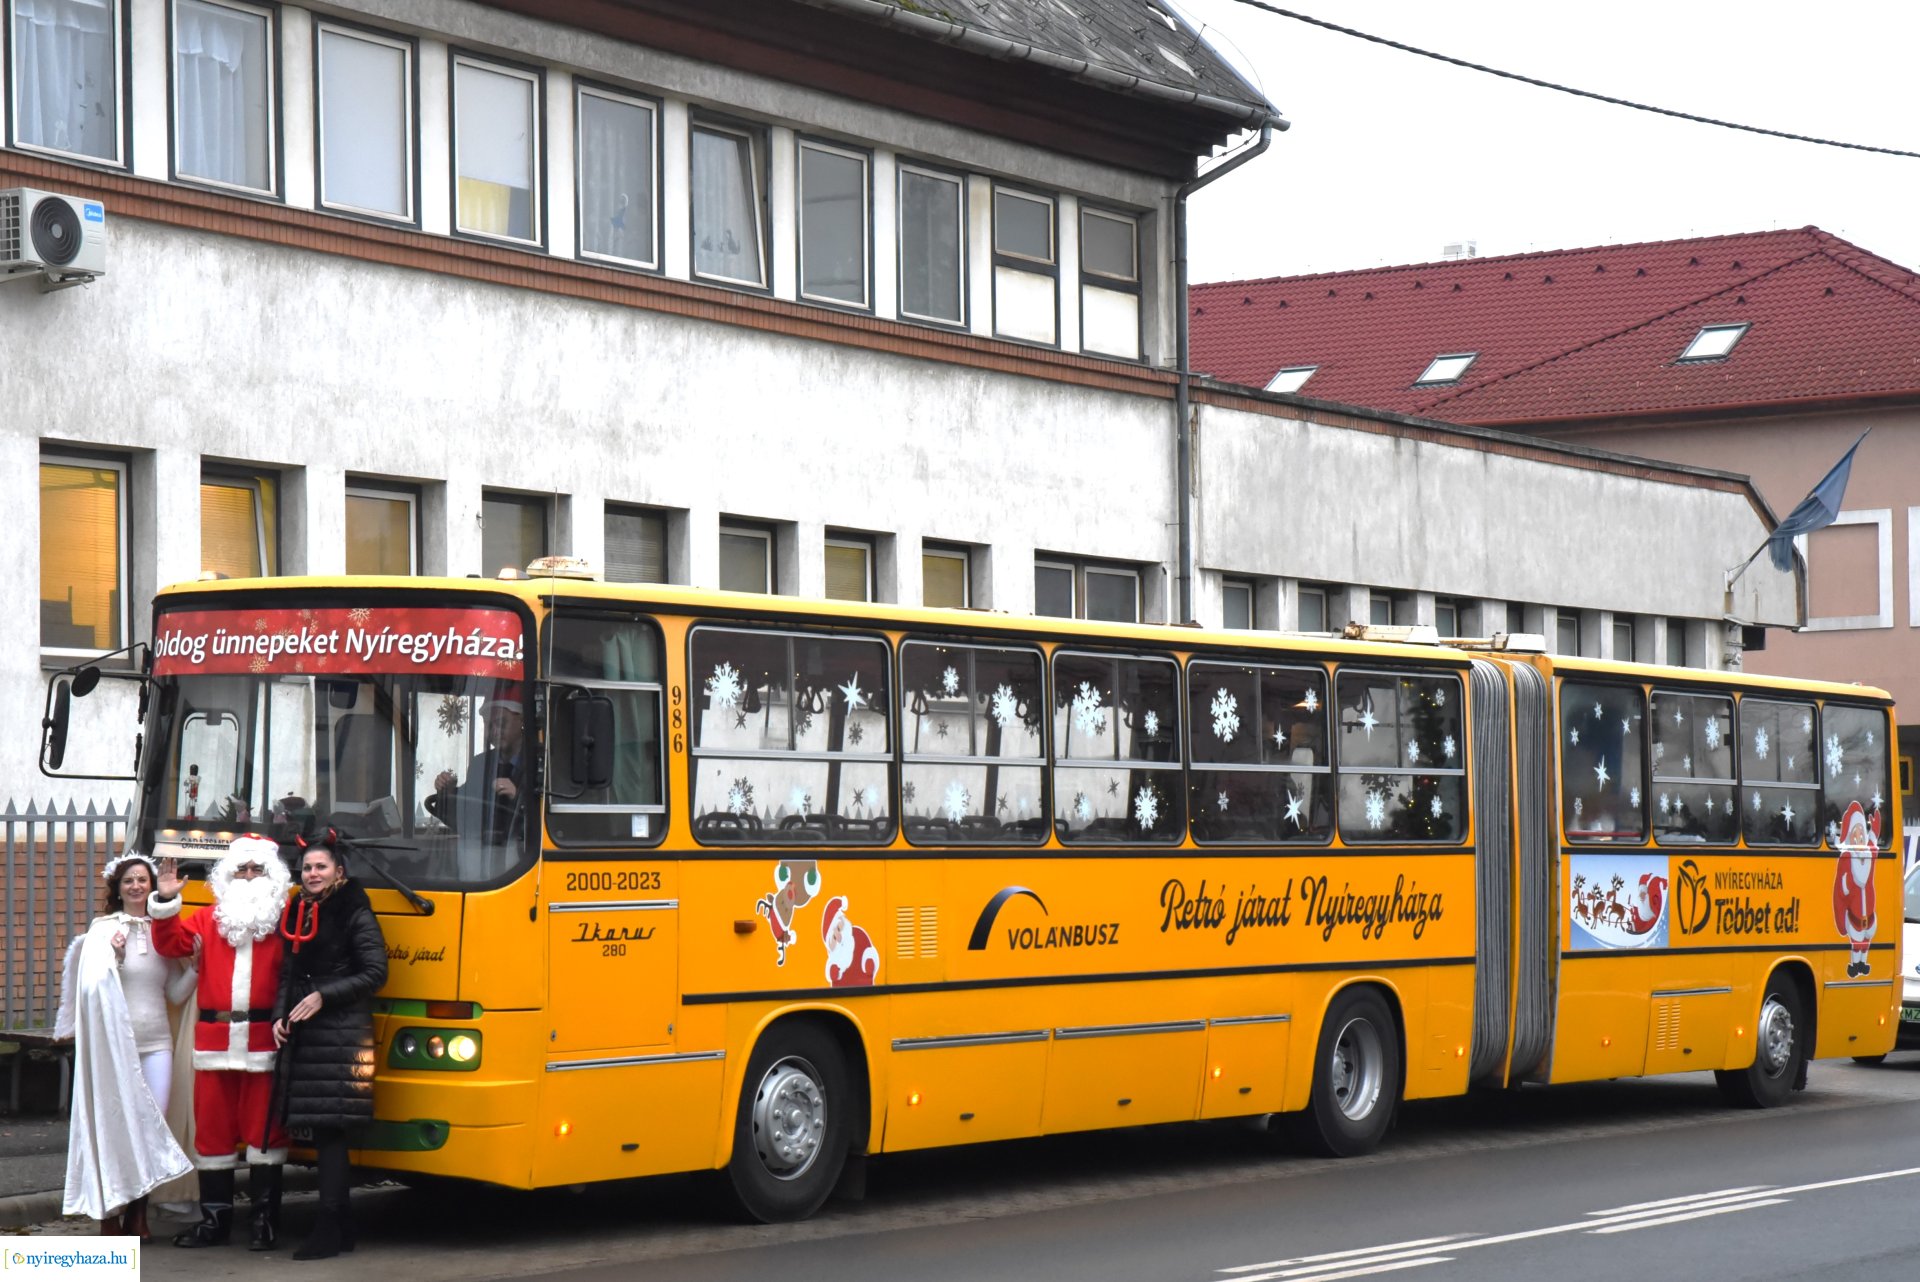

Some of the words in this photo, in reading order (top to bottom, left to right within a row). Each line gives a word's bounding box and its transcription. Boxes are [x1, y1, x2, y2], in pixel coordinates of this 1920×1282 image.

[212, 627, 339, 662] ünnepeket
[344, 626, 524, 663] Nyíregyháza!
[672, 685, 683, 753] 986
[566, 871, 661, 891] 2000-2023
[1714, 867, 1783, 890] NYÍREGYHÁZA
[1159, 878, 1226, 933] Retró
[1225, 878, 1293, 946] járat
[1300, 873, 1444, 943] Nyíregyháza
[1714, 896, 1771, 935] Többet
[1774, 896, 1800, 933] ad!
[571, 922, 656, 942] Ikarus
[1007, 923, 1120, 950] VOLÁNBUSZ
[409, 946, 446, 966] járat
[602, 943, 626, 957] 280
